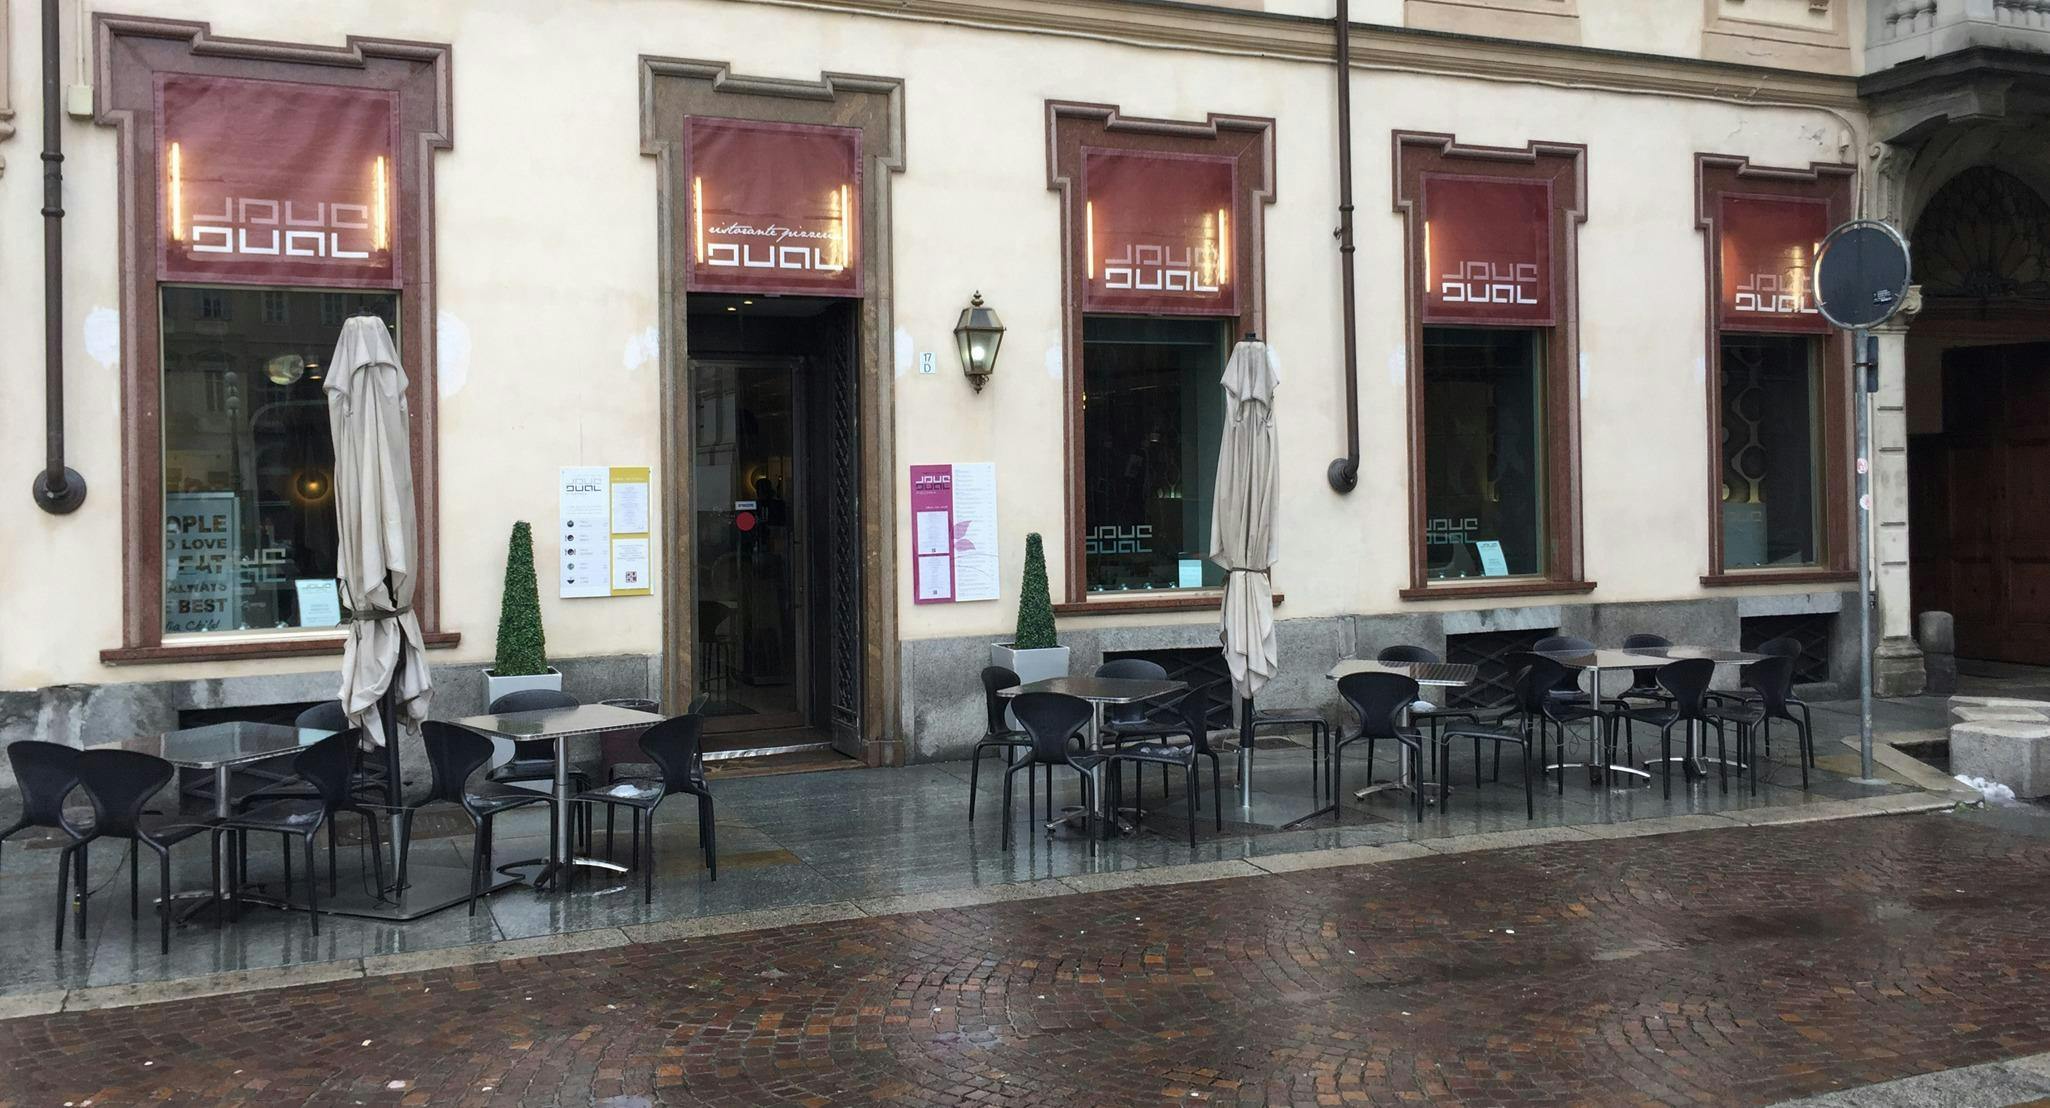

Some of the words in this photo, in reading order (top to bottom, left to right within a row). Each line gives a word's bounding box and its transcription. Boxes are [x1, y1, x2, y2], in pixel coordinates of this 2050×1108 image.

[708, 222, 778, 237] ristorante
[192, 226, 369, 259] DUAL
[707, 243, 844, 271] DUAL
[1105, 268, 1219, 292] DUAL
[1442, 282, 1538, 304] DUAL
[1736, 293, 1819, 313] DUAL
[923, 352, 932, 362] 17
[923, 363, 931, 373] D
[181, 538, 227, 550] LOVE
[177, 554, 227, 574] EAT
[178, 598, 228, 614] BEST
